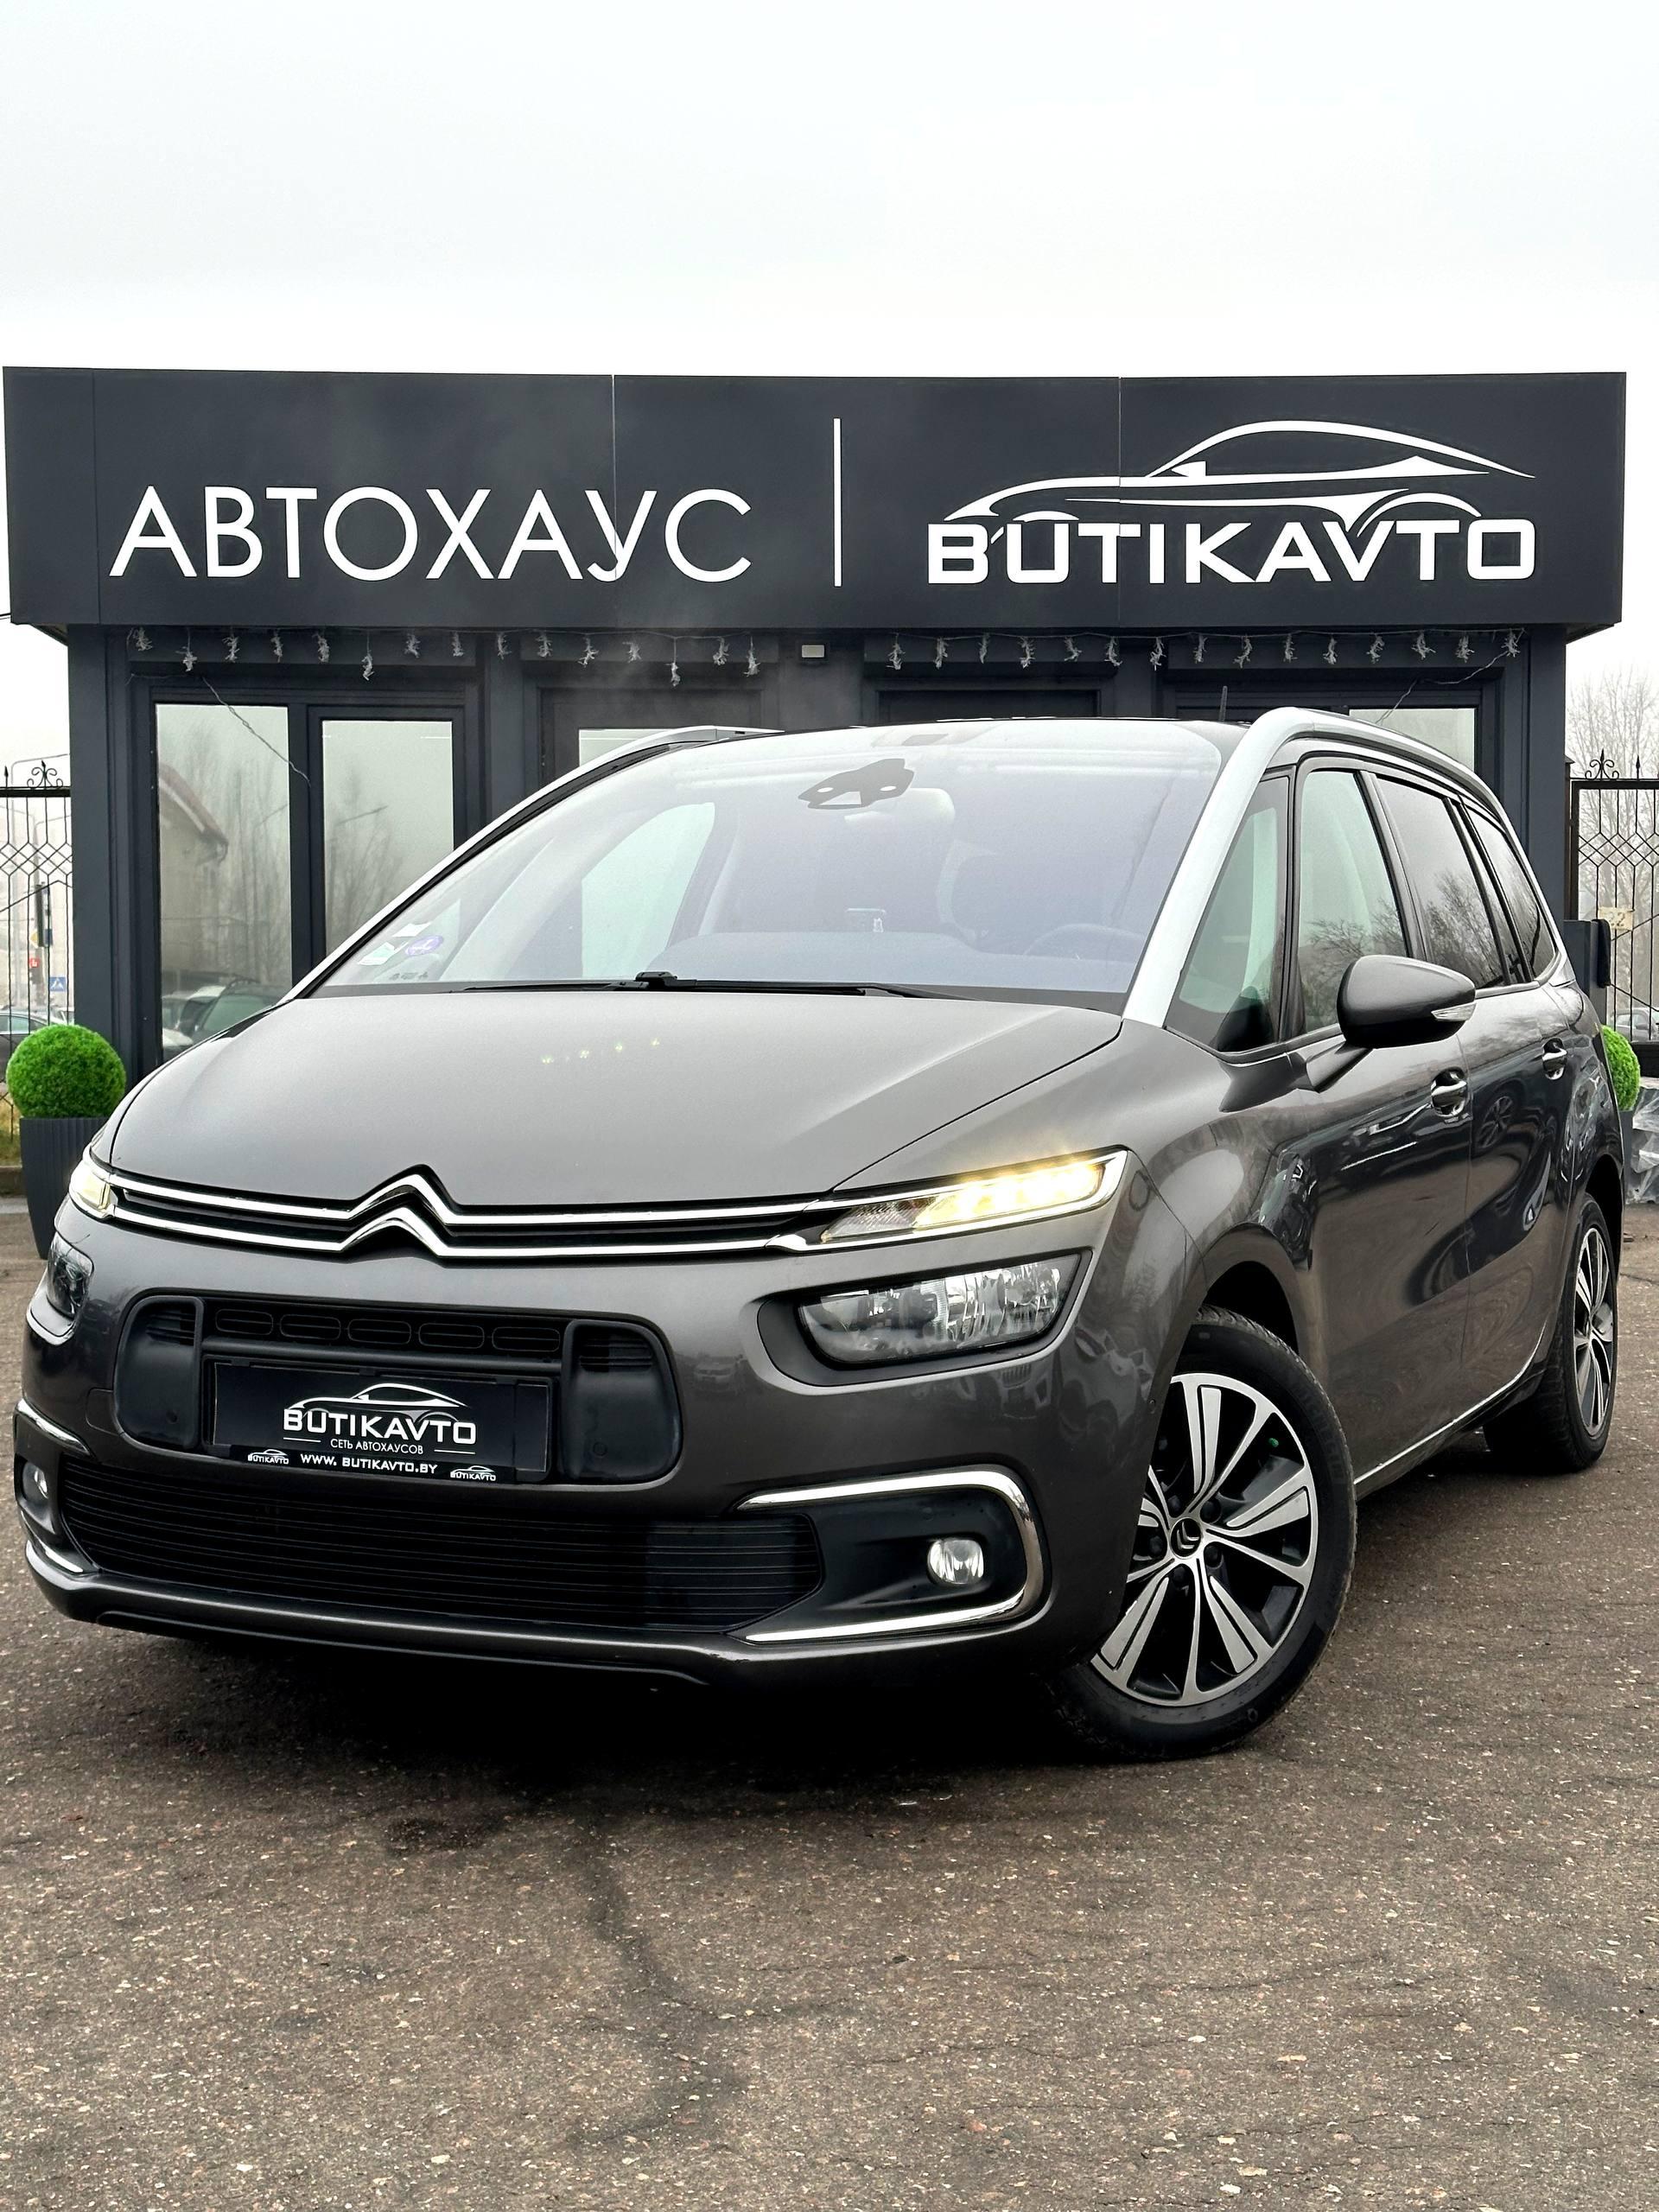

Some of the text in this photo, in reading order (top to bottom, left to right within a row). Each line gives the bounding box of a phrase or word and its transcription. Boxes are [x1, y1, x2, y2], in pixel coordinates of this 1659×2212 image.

[110, 486, 752, 582] АВТОХАУС
[927, 518, 1535, 585] BUTIKAVTO
[283, 1408, 476, 1445] BUTIKAVTO
[330, 1438, 424, 1455] СЕТЬ АВТОХАУСОВ
[247, 1453, 289, 1465] BUTIKAVTO
[341, 1457, 438, 1474] BUTIKAVTO.BY
[450, 1471, 496, 1482] BUTIKAVTO
